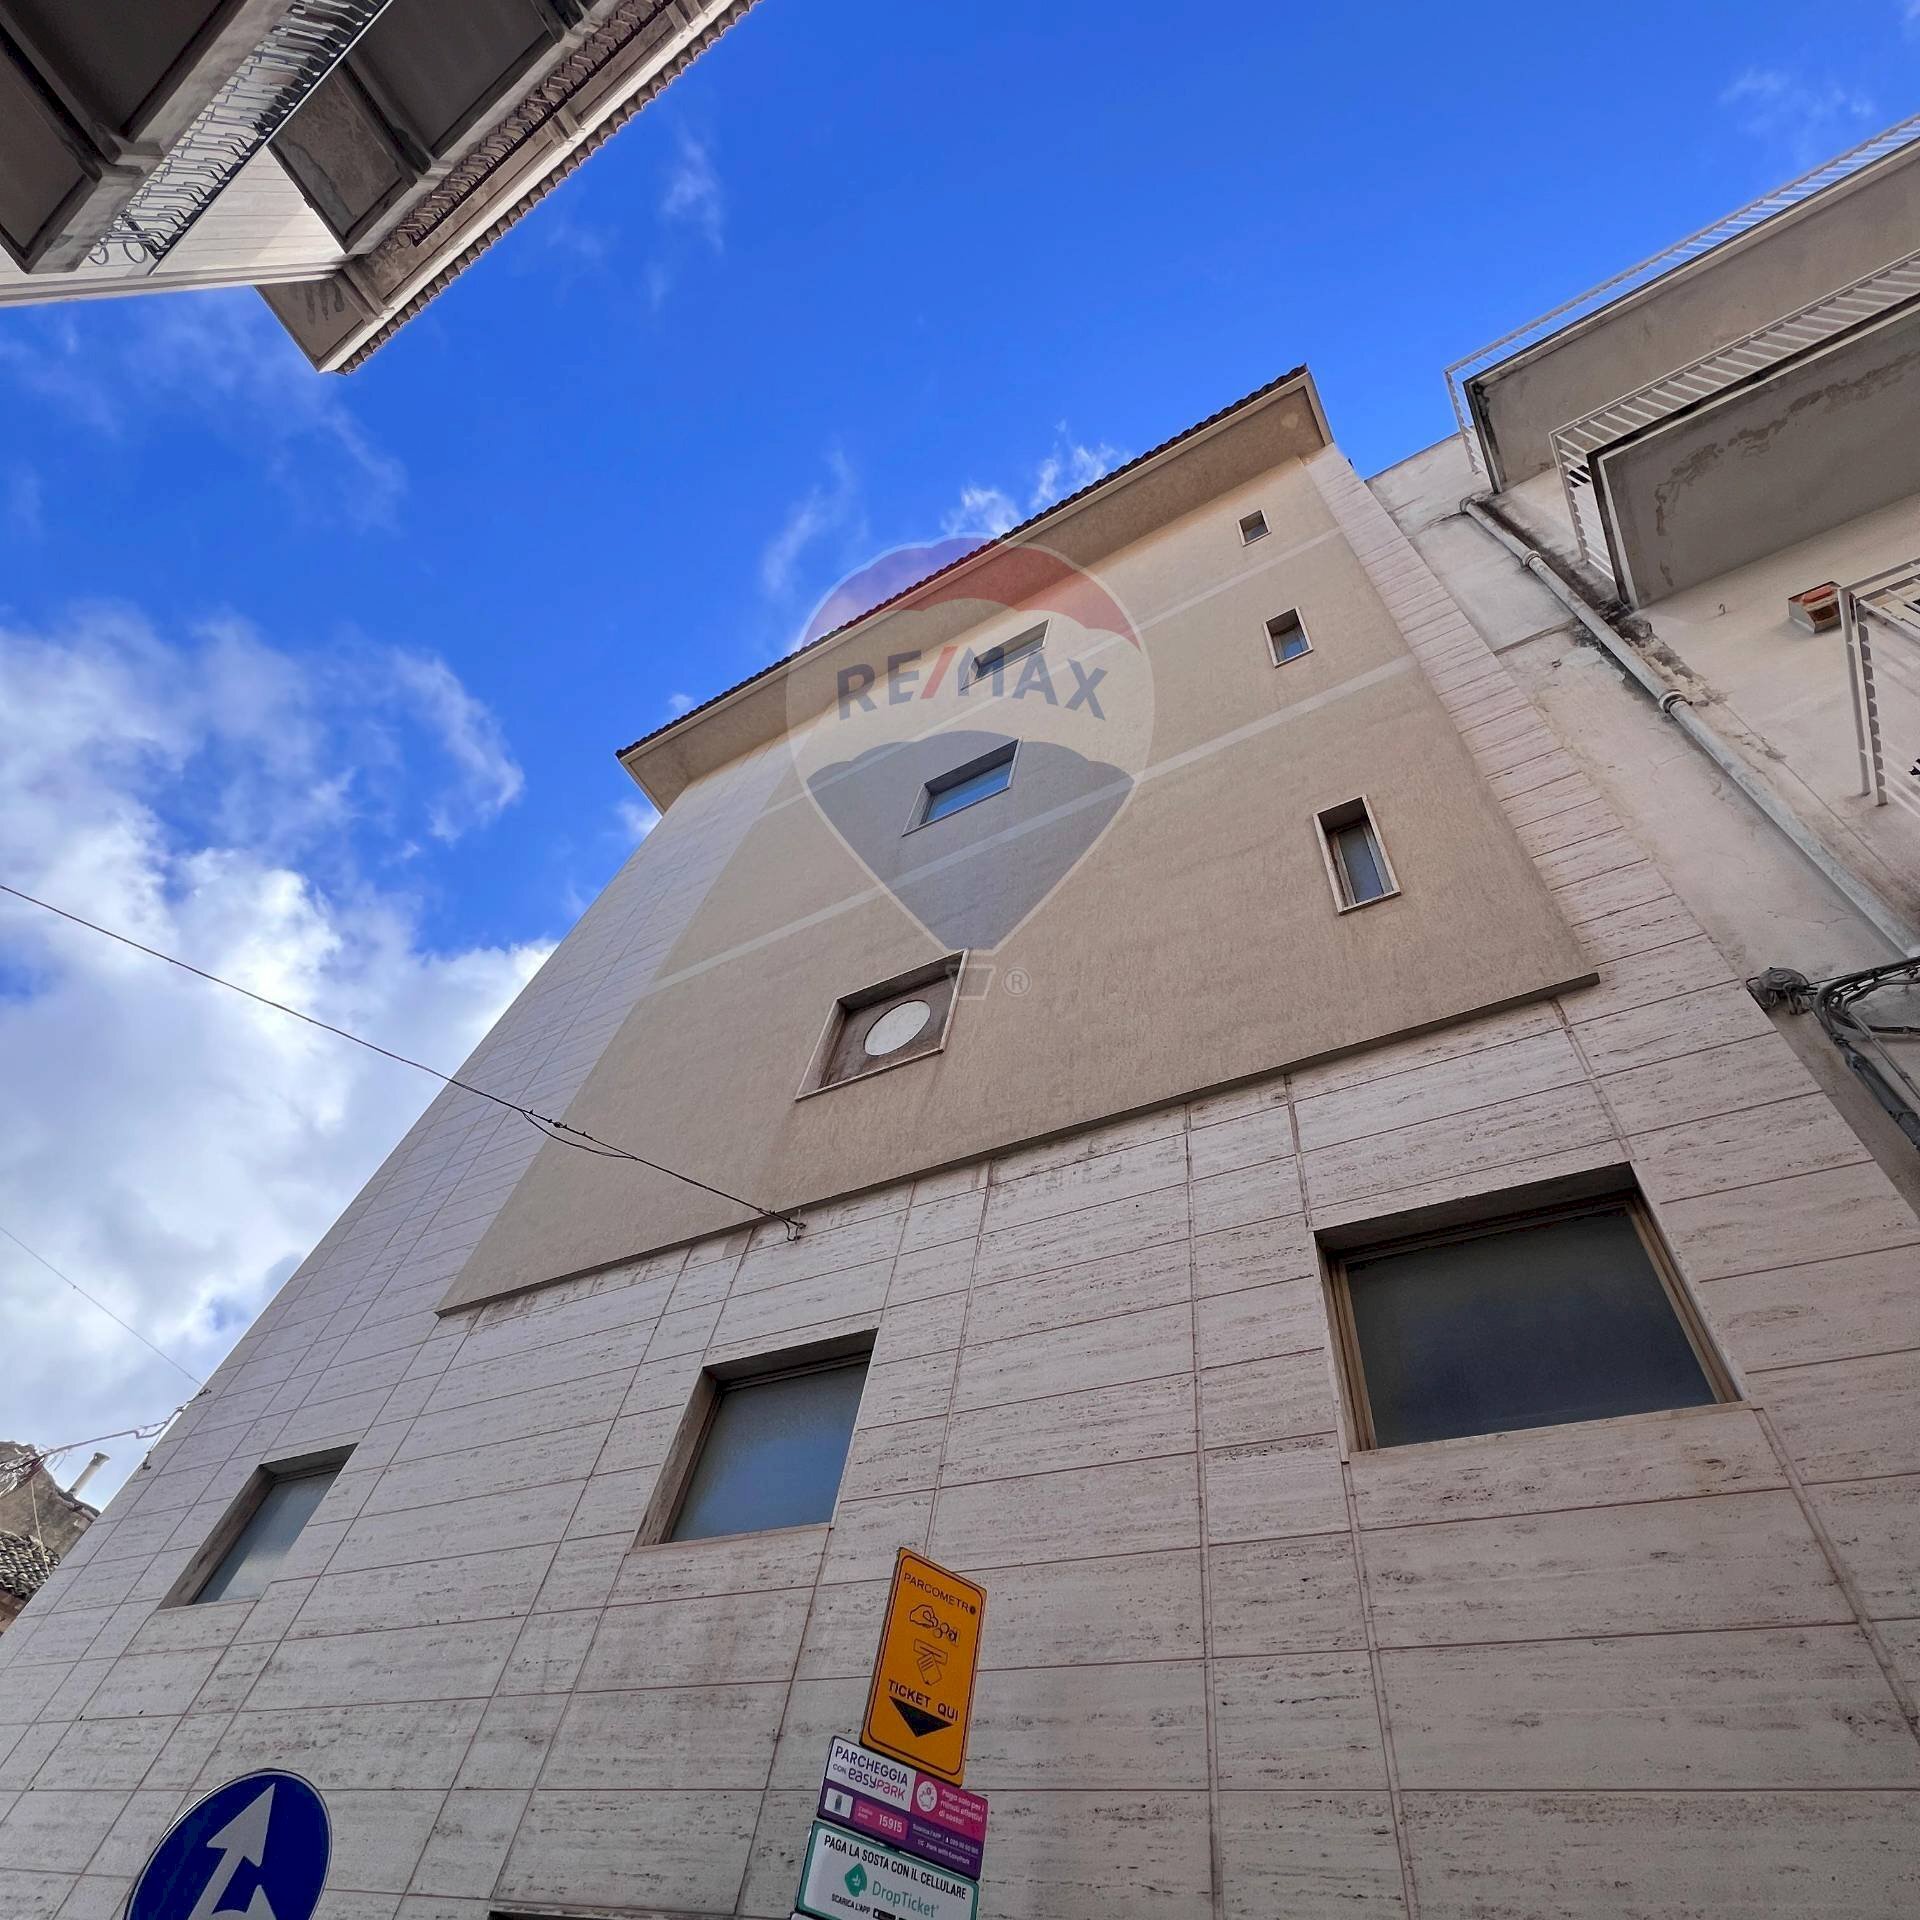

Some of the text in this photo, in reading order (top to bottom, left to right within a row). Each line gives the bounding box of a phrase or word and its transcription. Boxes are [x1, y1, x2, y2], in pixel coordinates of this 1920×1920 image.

[904, 1572, 977, 1616] PARCOMETRO
[888, 1679, 959, 1721] TICKET QUI
[835, 1746, 908, 1787] PARCHEGGIA
[879, 1814, 903, 1833] 15915
[824, 1834, 847, 1854] PAGA
[848, 1843, 860, 1858] LA
[861, 1849, 889, 1870] SOSTA
[891, 1860, 909, 1878] CON
[920, 1872, 967, 1900] CELLULARE
[831, 1893, 855, 1908] SCARICA
[872, 1881, 936, 1918] DropTicket
